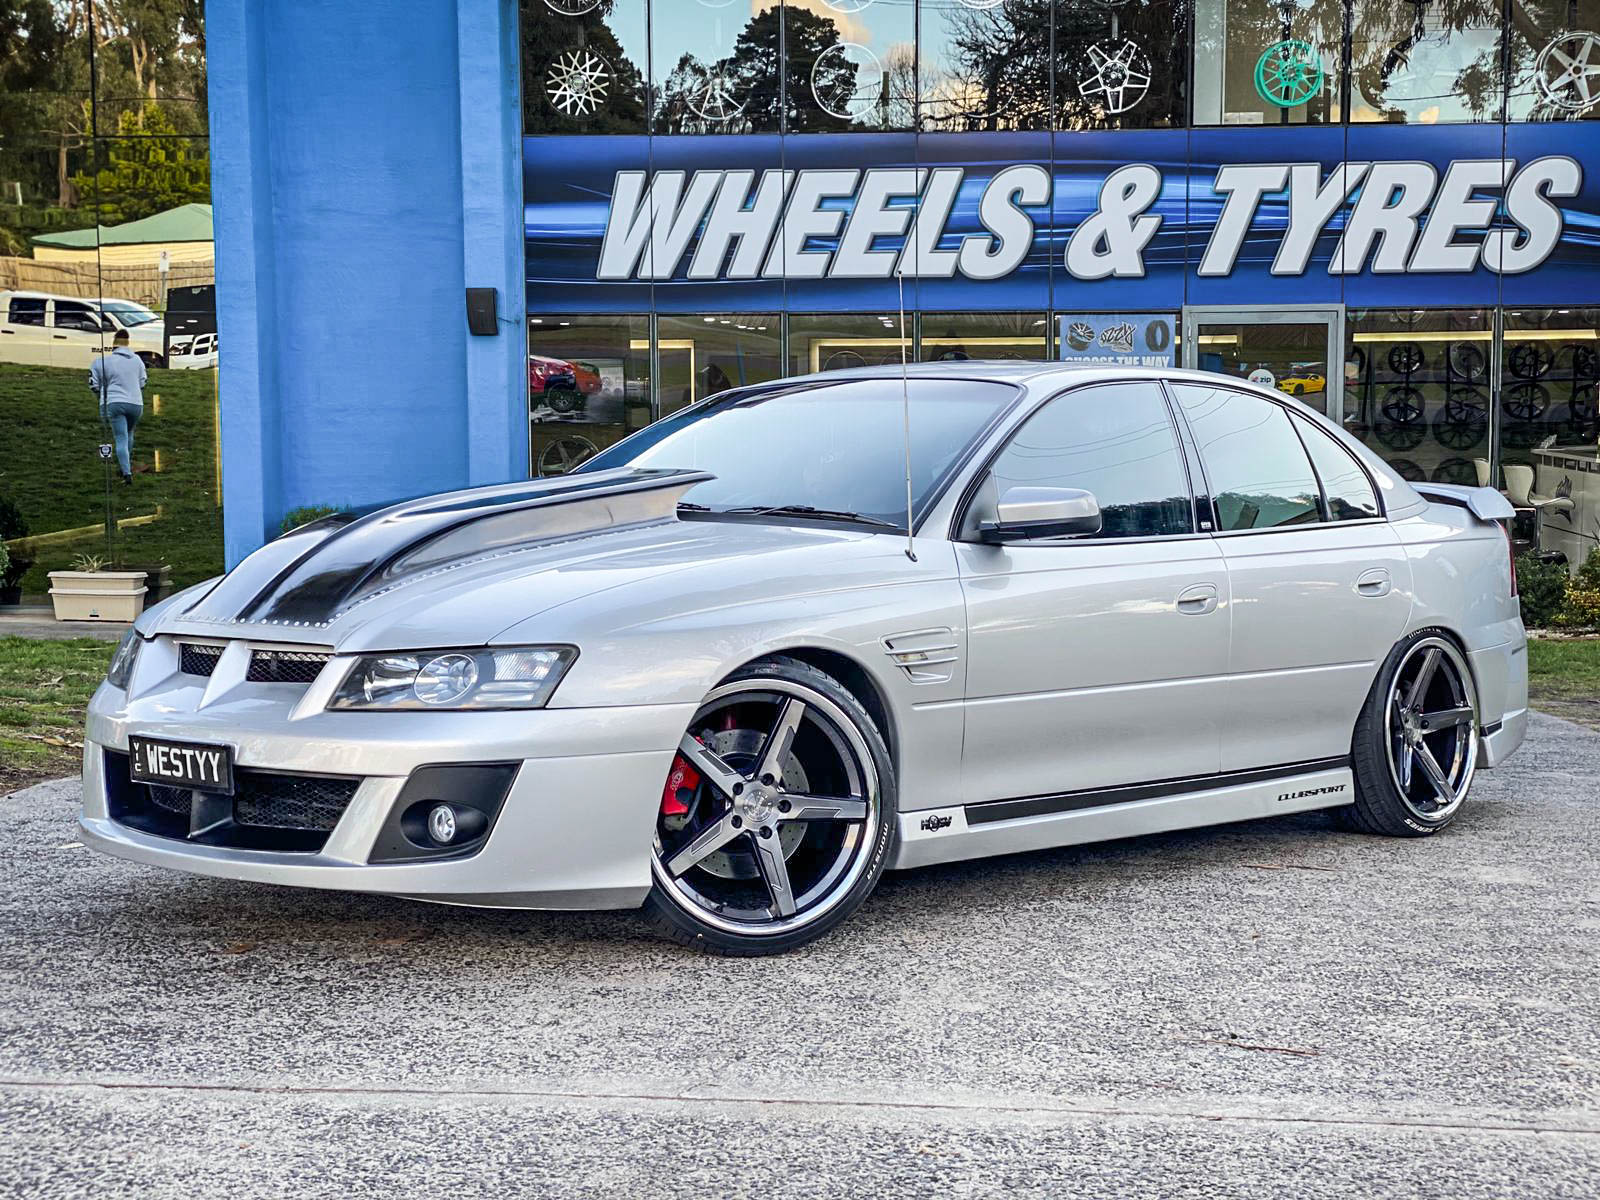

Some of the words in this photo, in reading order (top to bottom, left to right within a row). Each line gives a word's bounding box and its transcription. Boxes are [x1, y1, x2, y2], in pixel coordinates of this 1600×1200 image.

[596, 164, 1051, 279] WHEELS
[1065, 163, 1162, 277] &
[1197, 155, 1582, 275] TYRES
[1116, 356, 1139, 366] THE
[1142, 356, 1170, 368] WAY
[133, 742, 142, 771] VIC
[146, 744, 220, 782] WESTYY
[1278, 784, 1346, 801] CLUBSPORT
